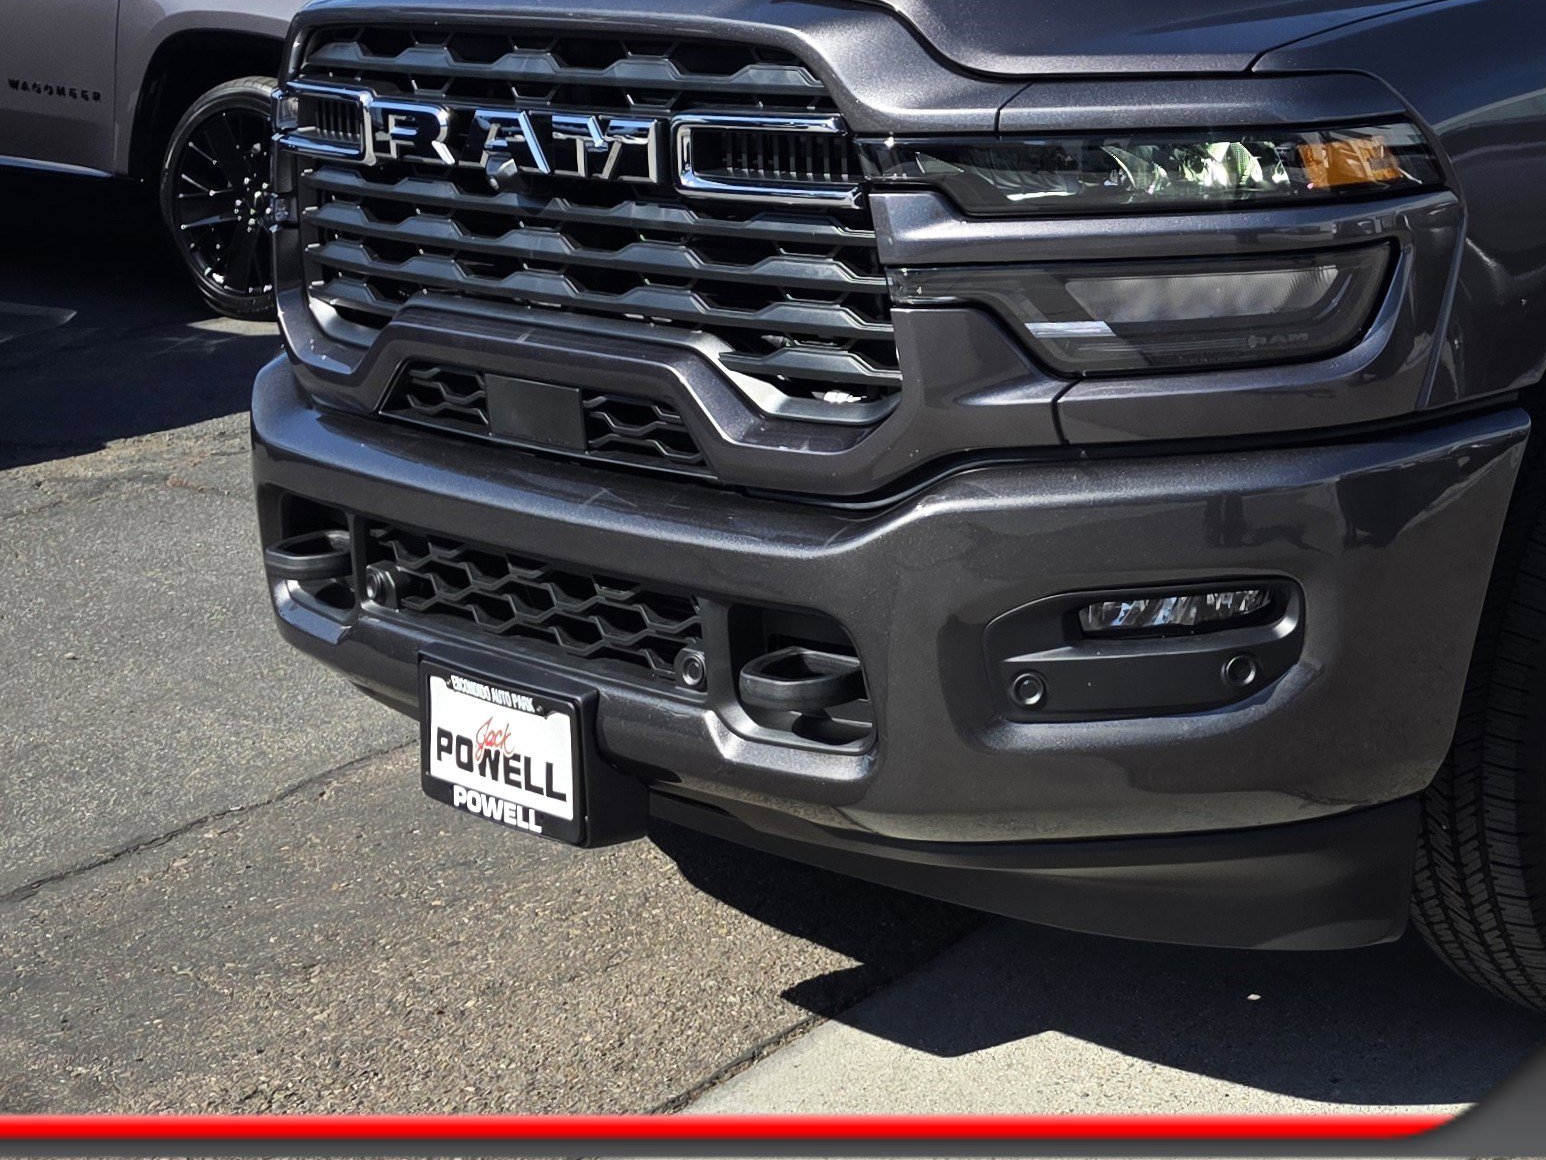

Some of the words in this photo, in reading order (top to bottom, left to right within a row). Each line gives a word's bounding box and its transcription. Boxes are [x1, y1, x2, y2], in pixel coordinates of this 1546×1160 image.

[366, 99, 660, 186] RAM
[491, 687, 512, 708] AUTO
[511, 692, 536, 713] PARK
[475, 715, 515, 762] Jack
[436, 726, 568, 802] POWELL
[453, 784, 543, 834] POWELL
